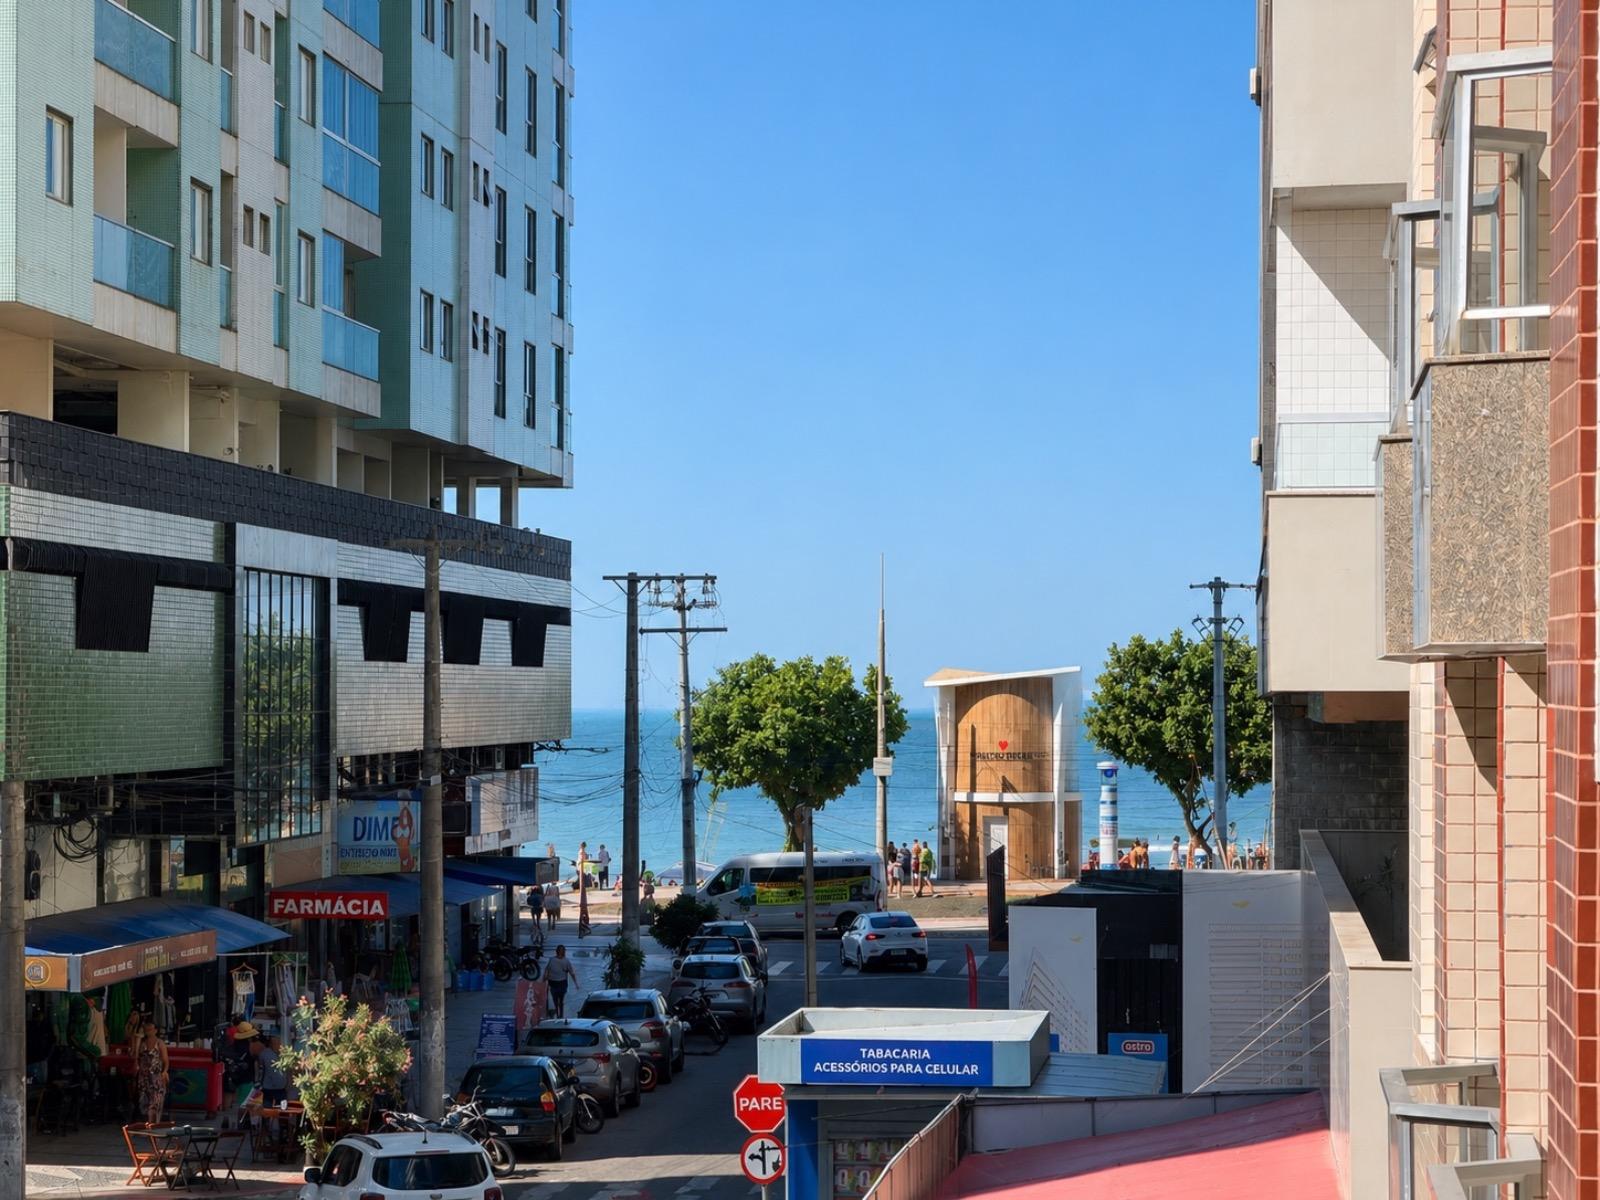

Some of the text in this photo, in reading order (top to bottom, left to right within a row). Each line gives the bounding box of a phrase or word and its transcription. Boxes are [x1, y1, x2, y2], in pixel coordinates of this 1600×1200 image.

[273, 896, 385, 915] FARMÁCIA
[860, 1048, 931, 1059] TABACARIA
[814, 1061, 979, 1075] ACESSÓRIOS PARA CELULAR
[739, 1096, 783, 1111] PARE
